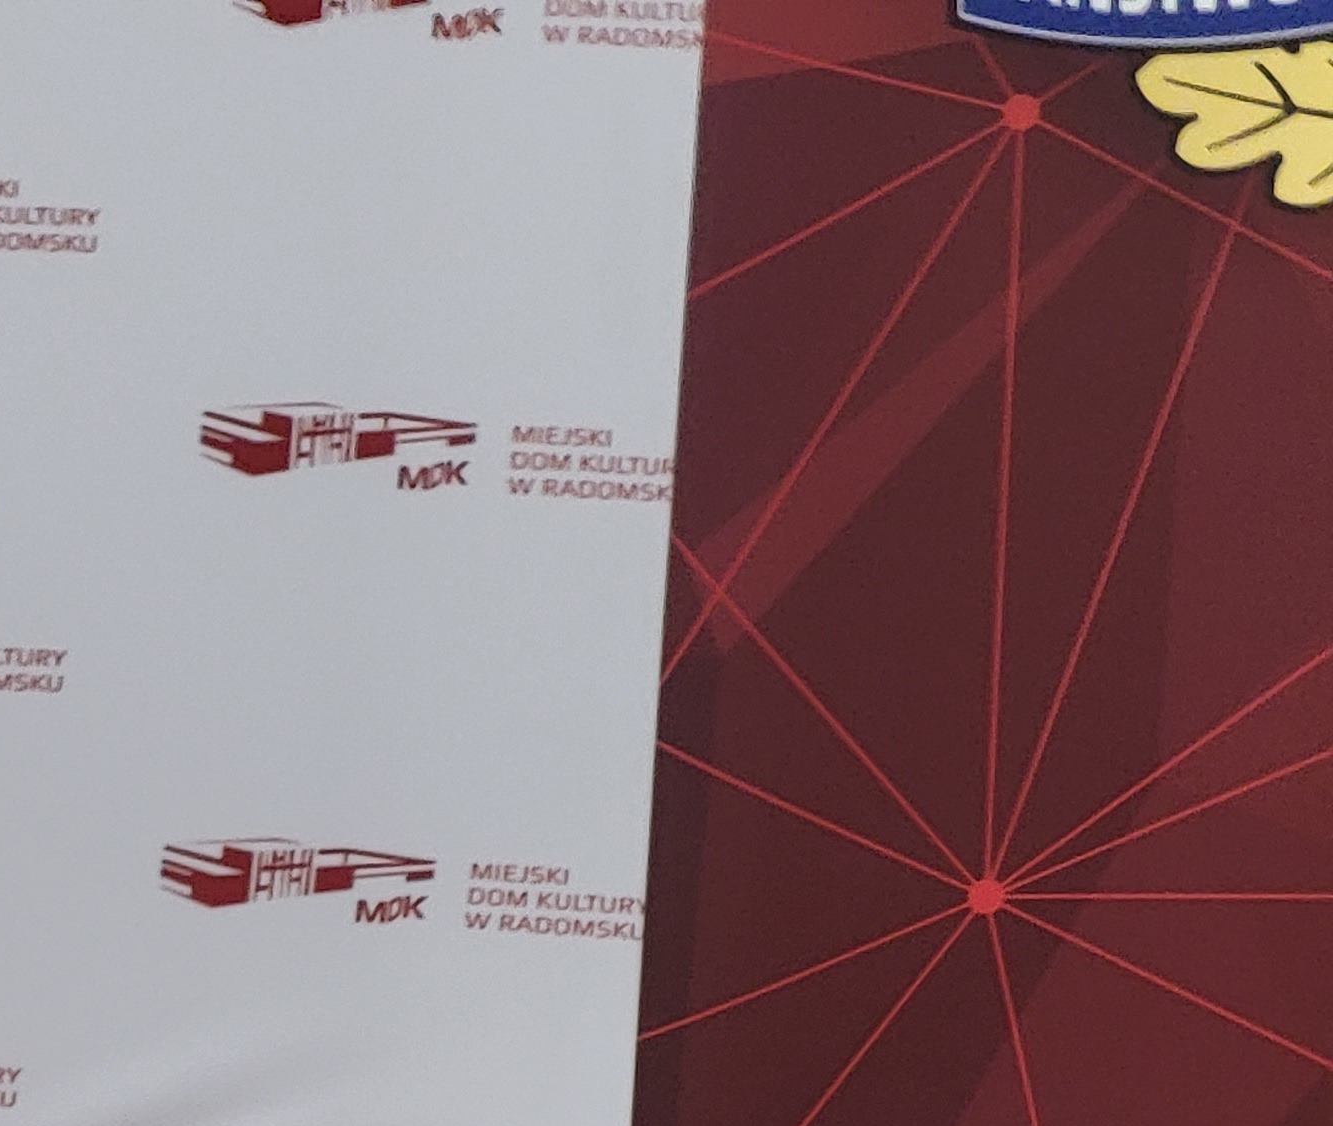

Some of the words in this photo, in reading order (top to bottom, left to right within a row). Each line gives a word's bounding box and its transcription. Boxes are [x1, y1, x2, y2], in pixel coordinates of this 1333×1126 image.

[512, 425, 613, 447] MIEJSKI
[510, 451, 571, 471] DOM
[397, 460, 470, 490] MDK
[509, 477, 535, 495] W
[542, 479, 672, 500] RADOMSK
[470, 863, 569, 885] MIEJSKI
[468, 887, 528, 907] DOM
[355, 895, 429, 923] MDK
[466, 912, 492, 929] W
